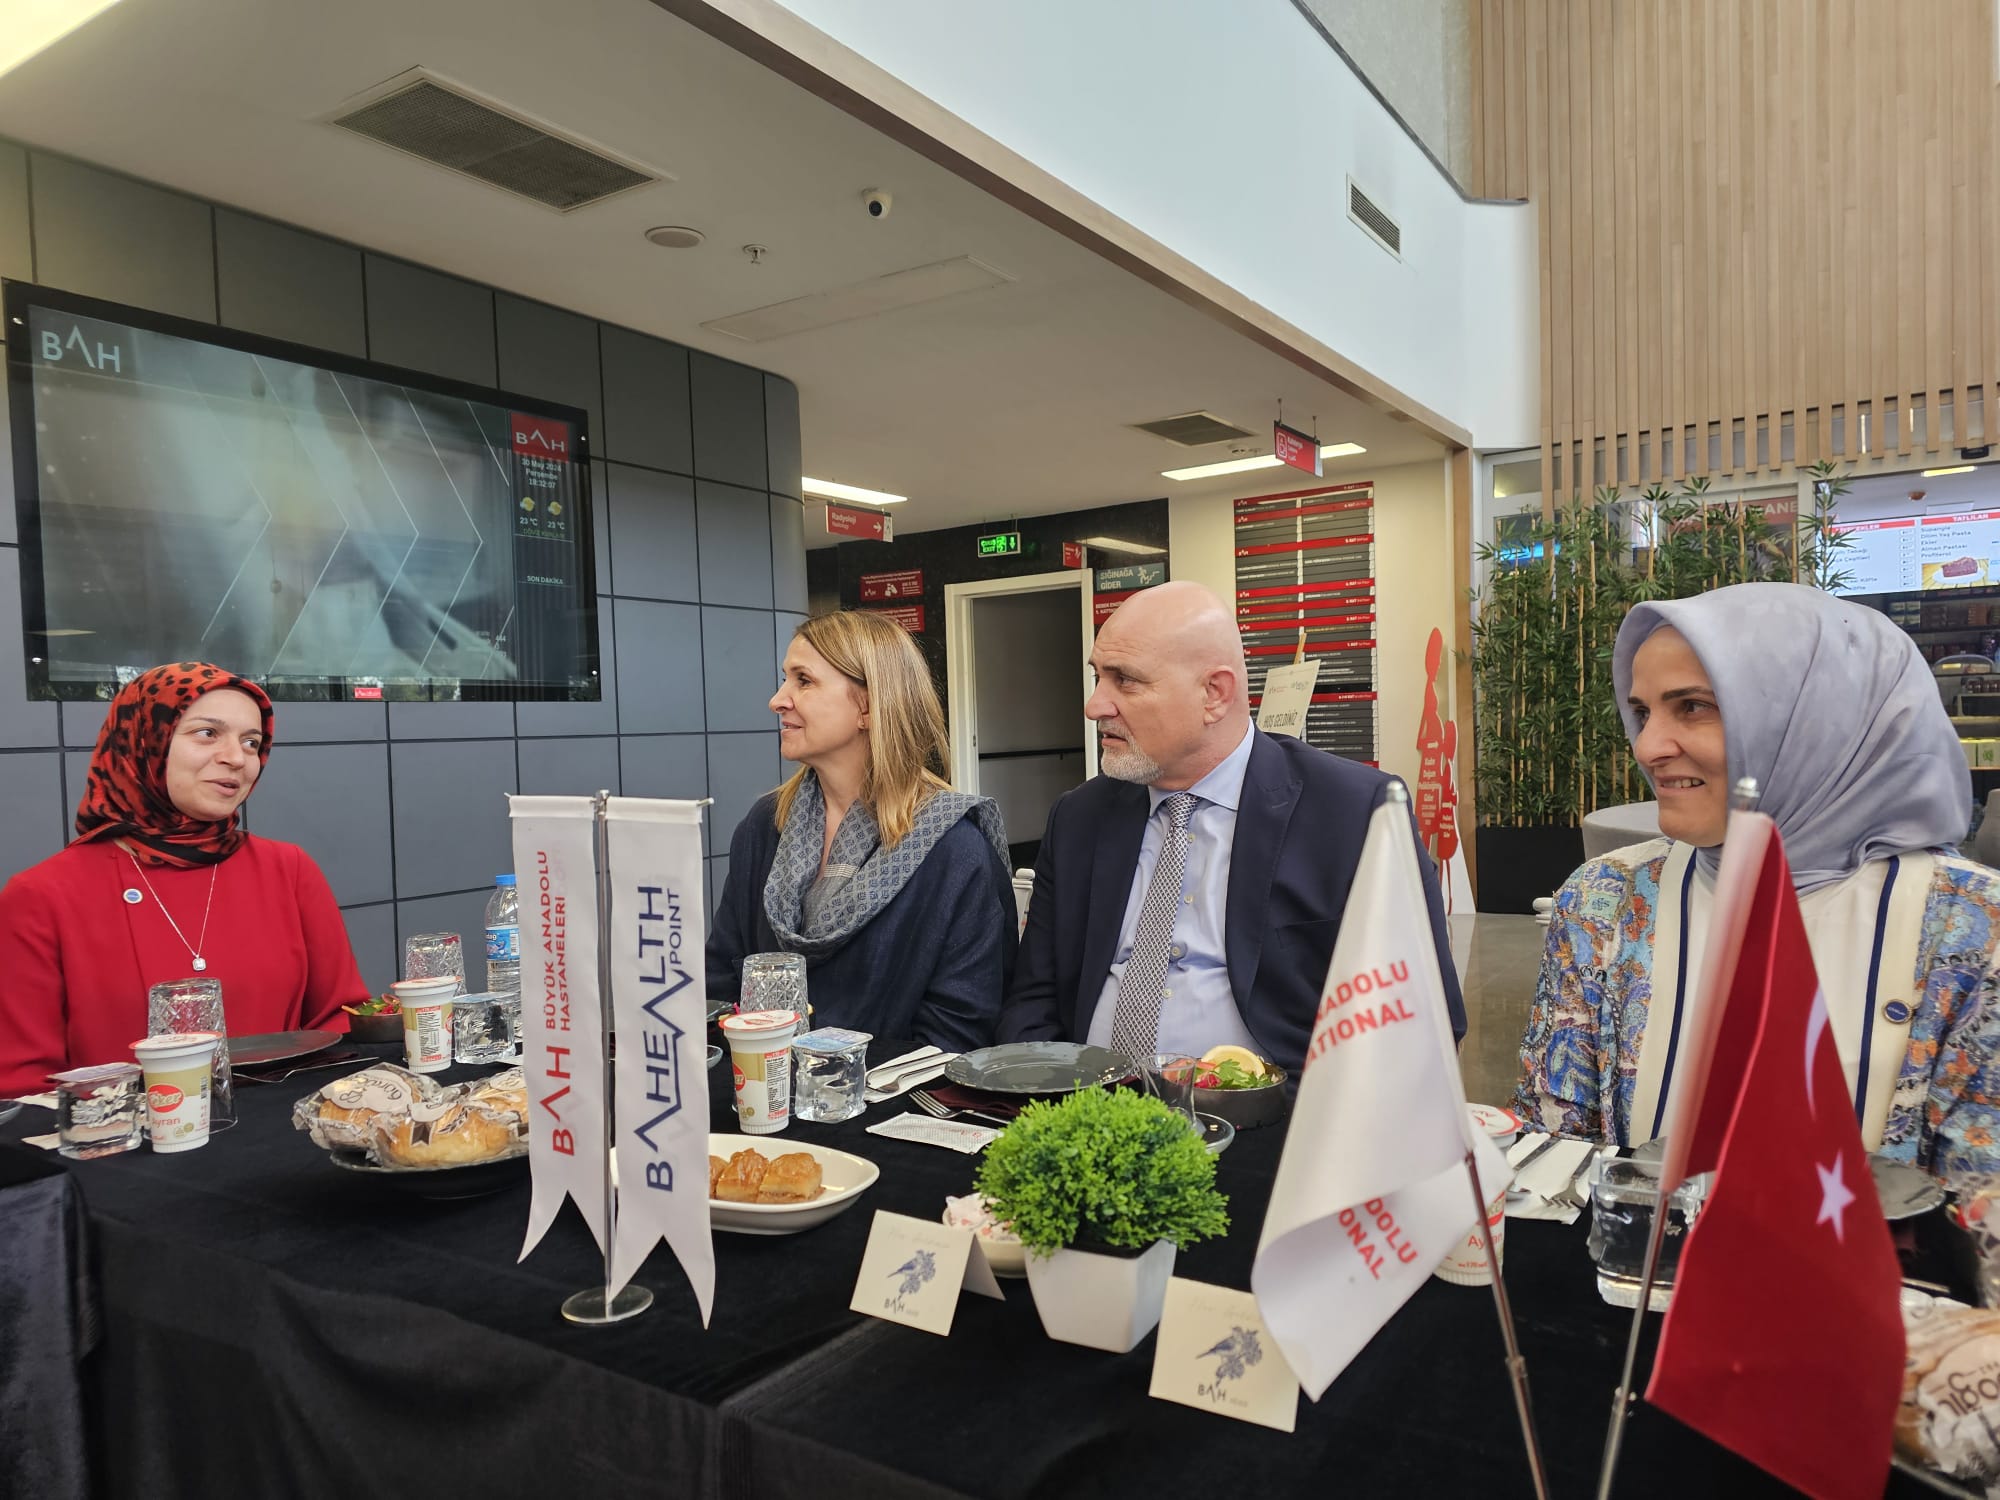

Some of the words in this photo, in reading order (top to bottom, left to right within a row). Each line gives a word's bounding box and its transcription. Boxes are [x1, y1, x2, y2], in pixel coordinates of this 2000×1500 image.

[519, 517, 528, 525] 23
[527, 575, 540, 583] SON
[1100, 568, 1134, 580] SIĞINAĞA
[1100, 580, 1122, 591] GİDER
[536, 850, 555, 954] ANADOLU
[667, 887, 683, 966] POINT
[543, 962, 557, 1030] BÜYÜK
[539, 1046, 575, 1157] BAH
[1467, 1232, 1503, 1249] Ayan
